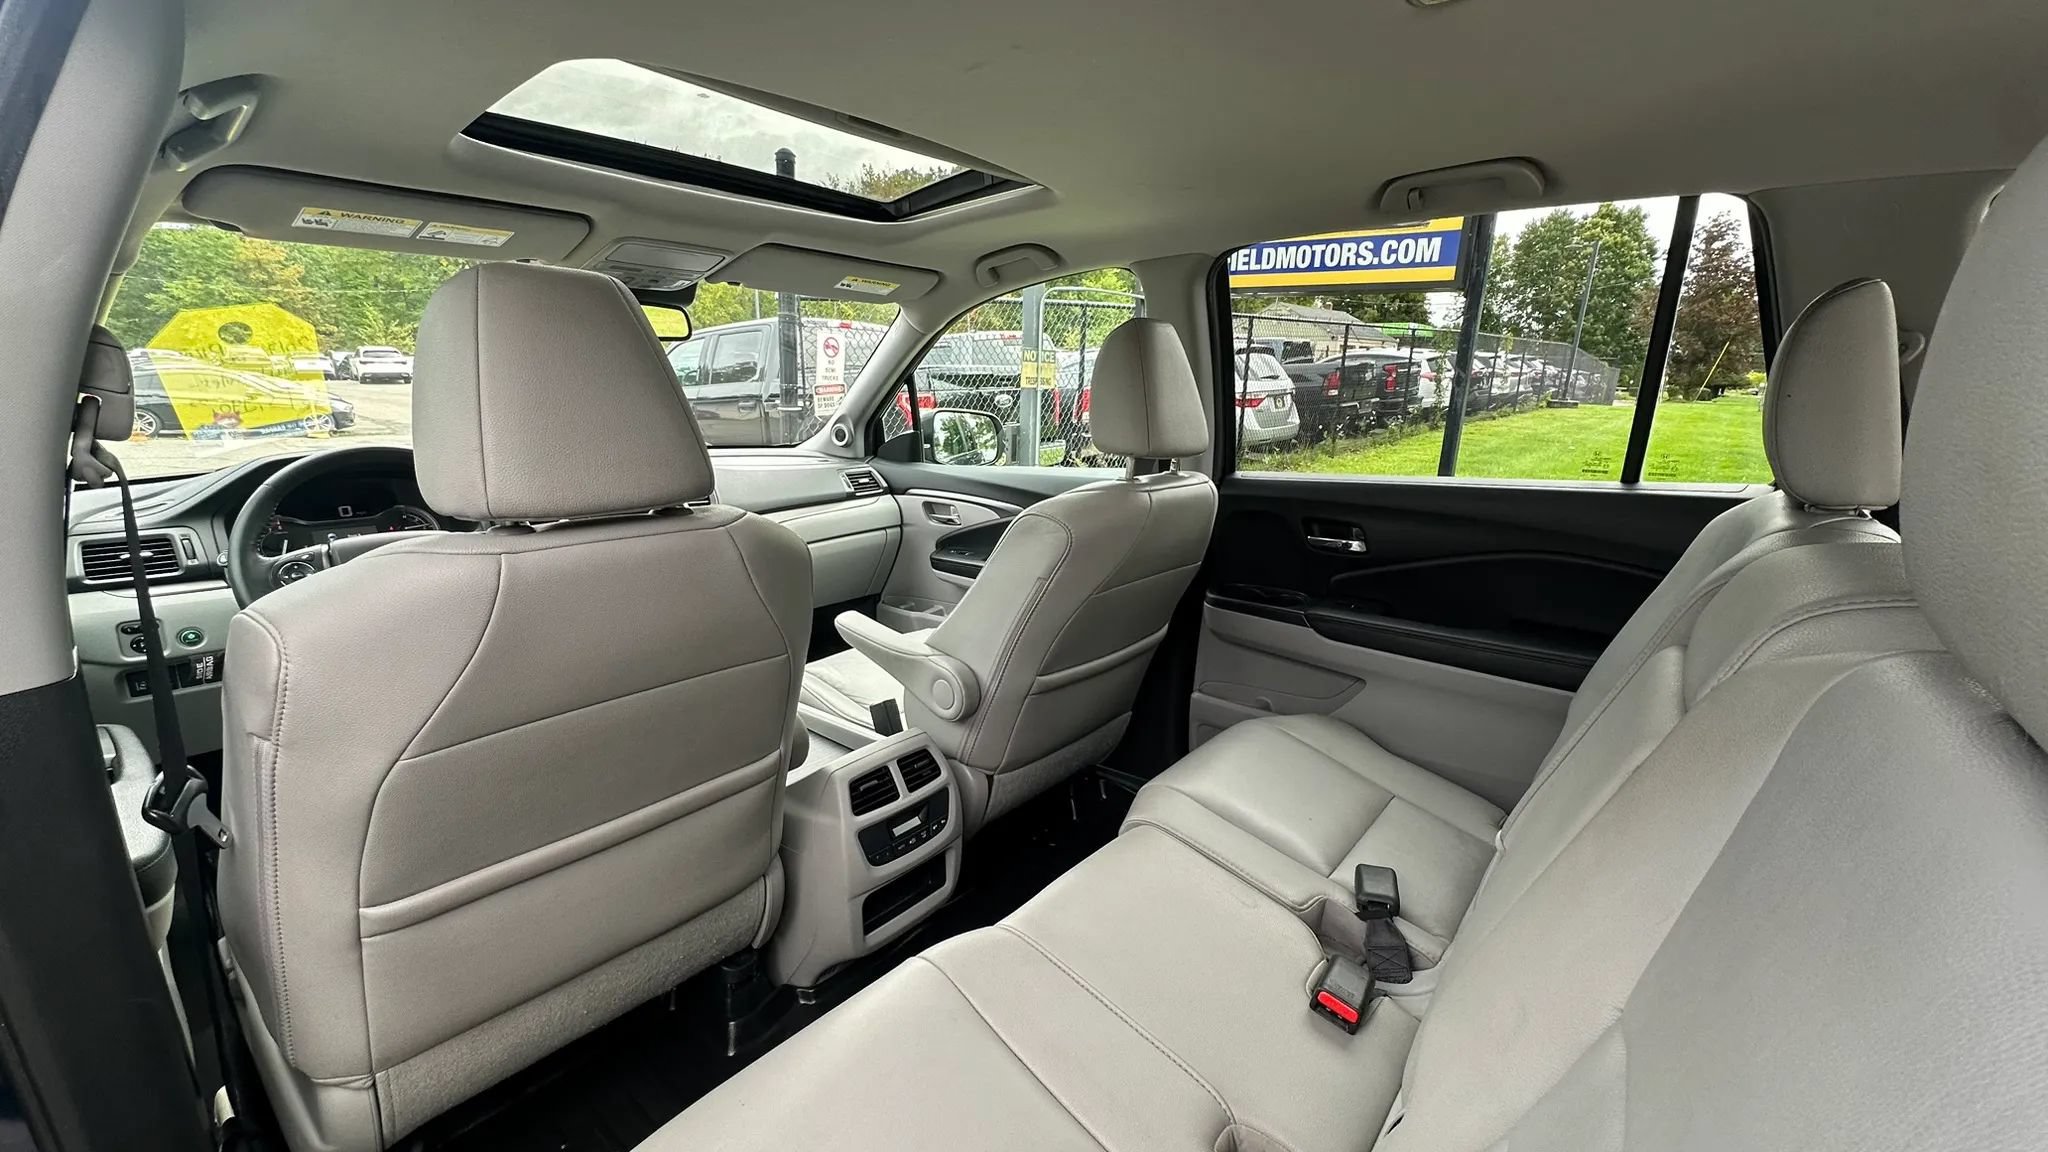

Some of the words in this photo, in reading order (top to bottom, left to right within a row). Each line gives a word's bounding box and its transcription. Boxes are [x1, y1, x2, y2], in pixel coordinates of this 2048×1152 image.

[341, 212, 405, 224] WARNING
[1228, 236, 1442, 271] IELDMOTORS.COM
[1023, 350, 1055, 362] NOICE
[338, 505, 353, 517] 0
